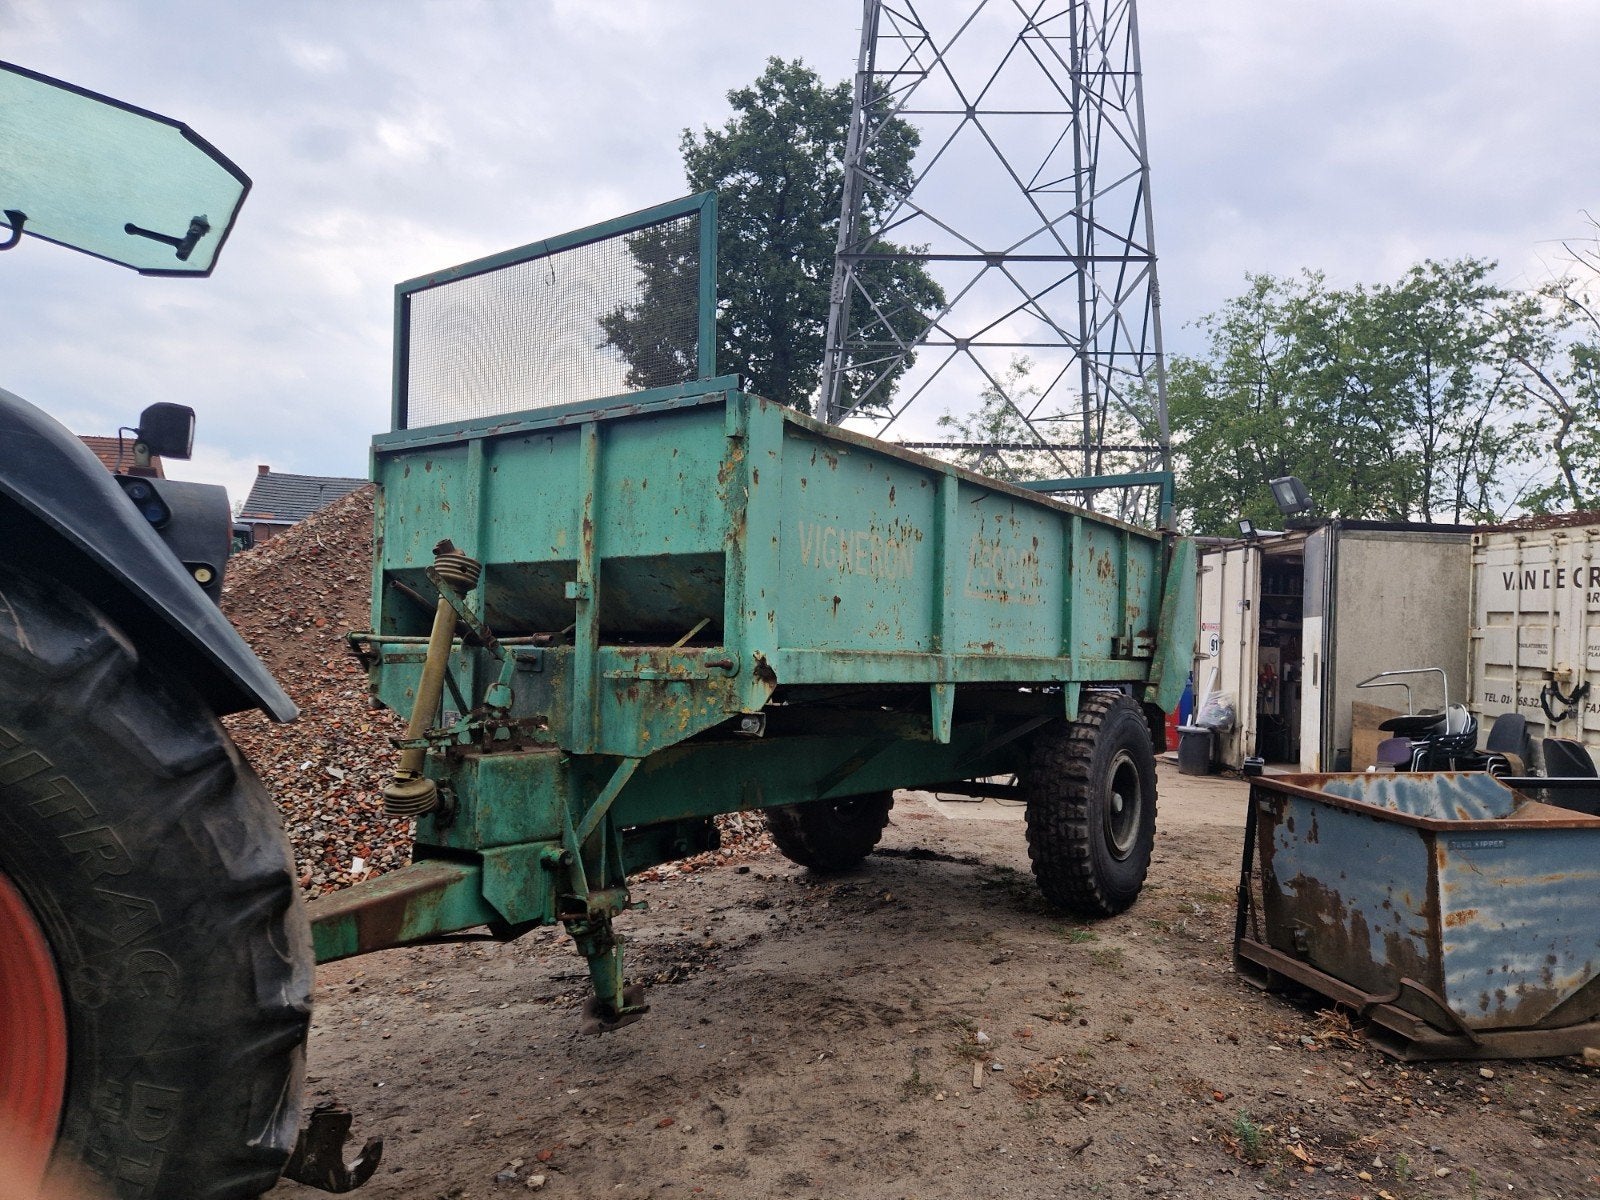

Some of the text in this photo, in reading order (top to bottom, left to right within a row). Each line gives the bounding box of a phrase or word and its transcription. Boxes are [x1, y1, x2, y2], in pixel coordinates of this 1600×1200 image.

[798, 520, 914, 579] VIGNERON
[1502, 570, 1537, 591] VAN
[1210, 638, 1219, 652] 91
[1484, 692, 1499, 703] TEL.
